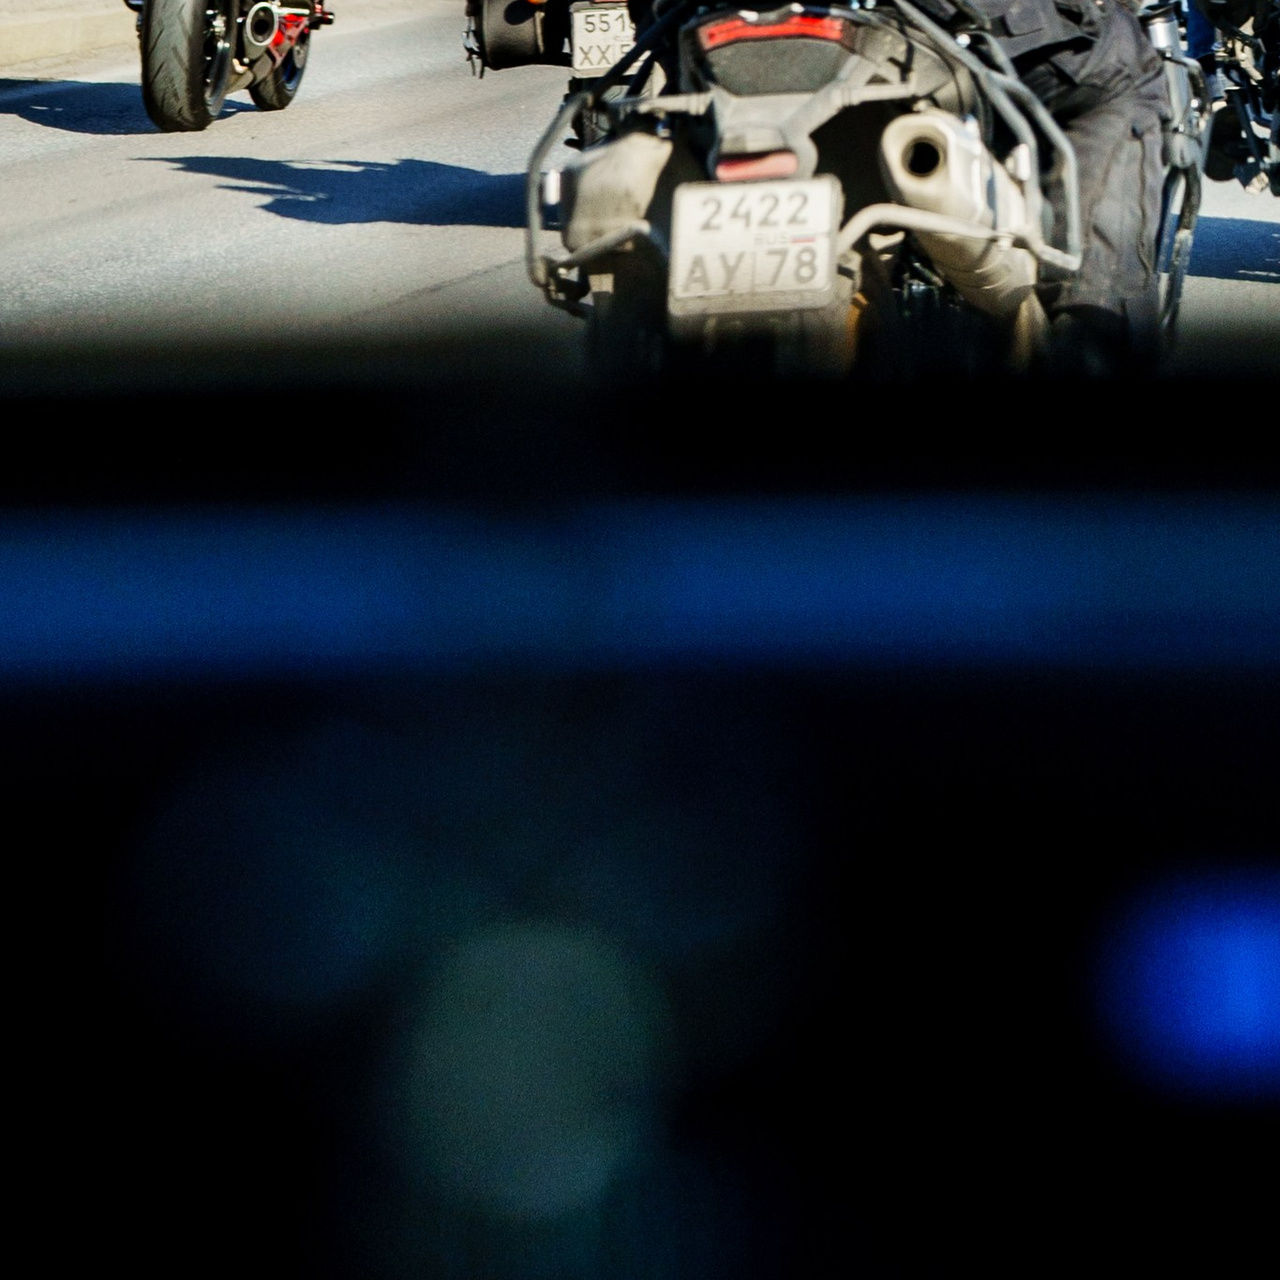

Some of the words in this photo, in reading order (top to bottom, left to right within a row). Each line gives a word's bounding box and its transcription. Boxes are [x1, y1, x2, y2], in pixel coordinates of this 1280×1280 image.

[584, 13, 637, 33] 551
[700, 191, 809, 231] 2422
[766, 247, 818, 287] 78
